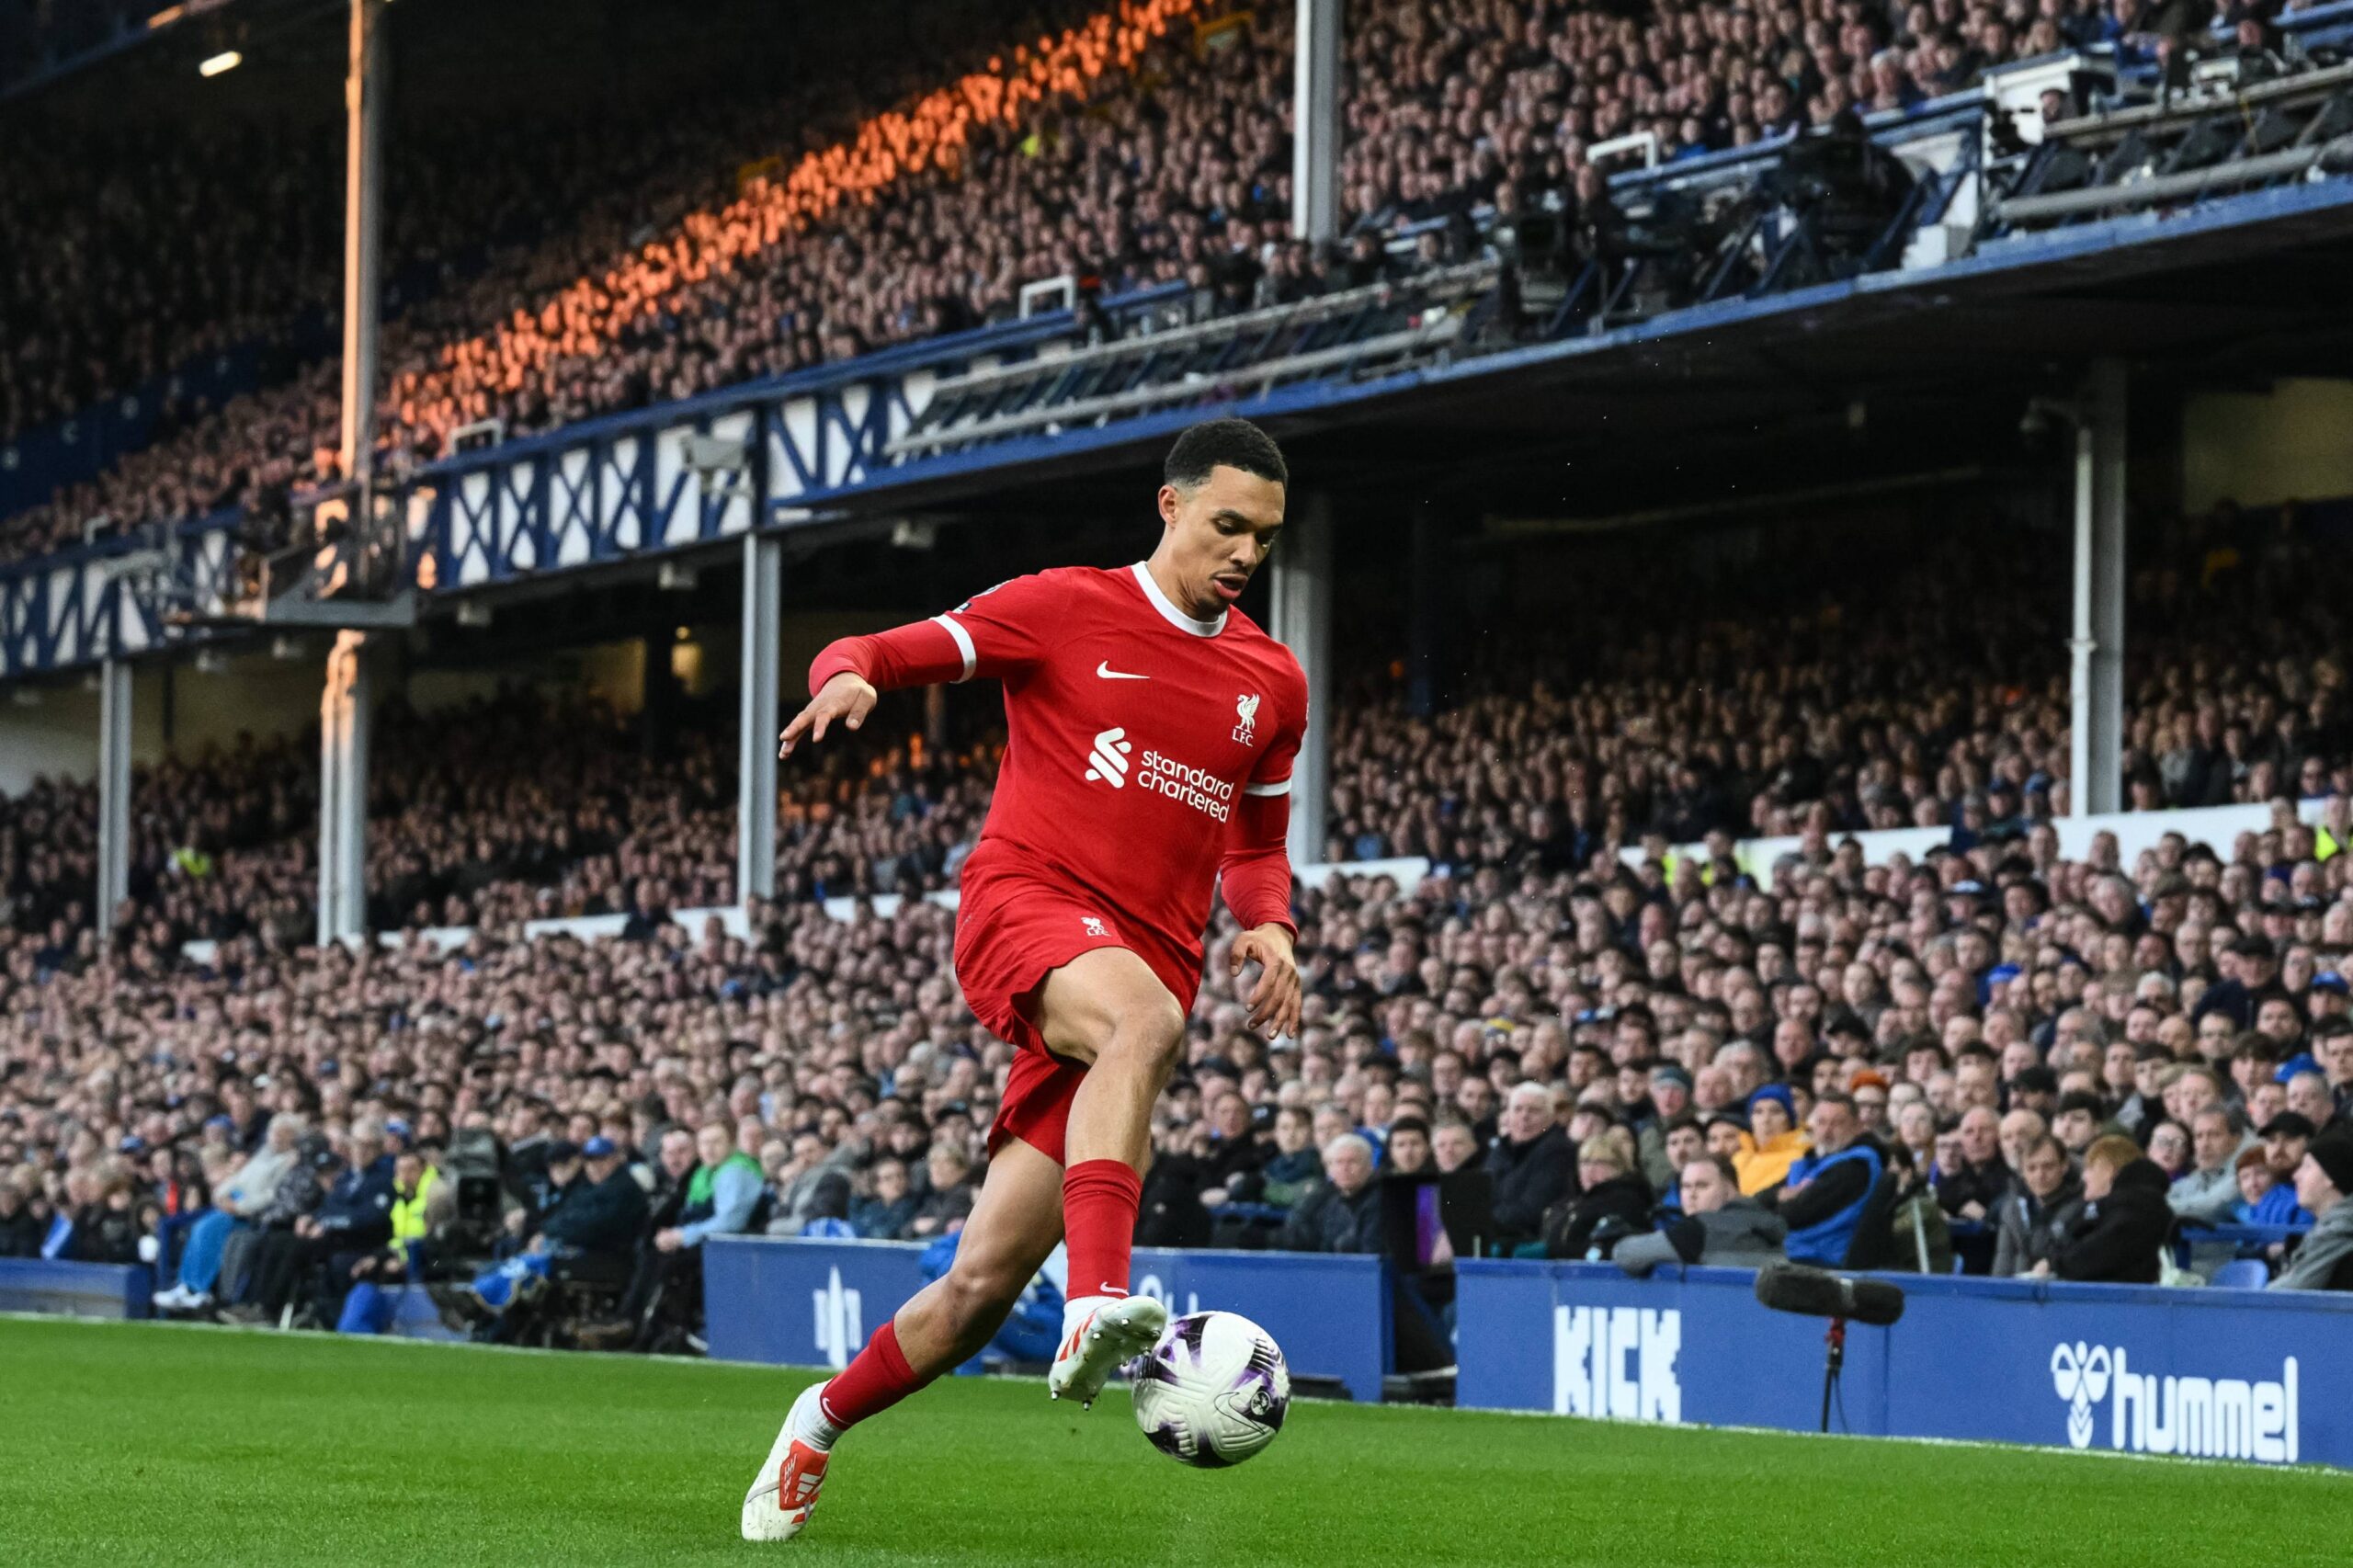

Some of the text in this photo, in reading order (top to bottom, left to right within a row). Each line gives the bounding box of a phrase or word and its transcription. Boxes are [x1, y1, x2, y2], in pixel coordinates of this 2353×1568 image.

[1137, 770, 1230, 824] chartered
[1141, 750, 1234, 801] standard
[1554, 1305, 1681, 1422] KICK
[2112, 1346, 2298, 1462] hummel
